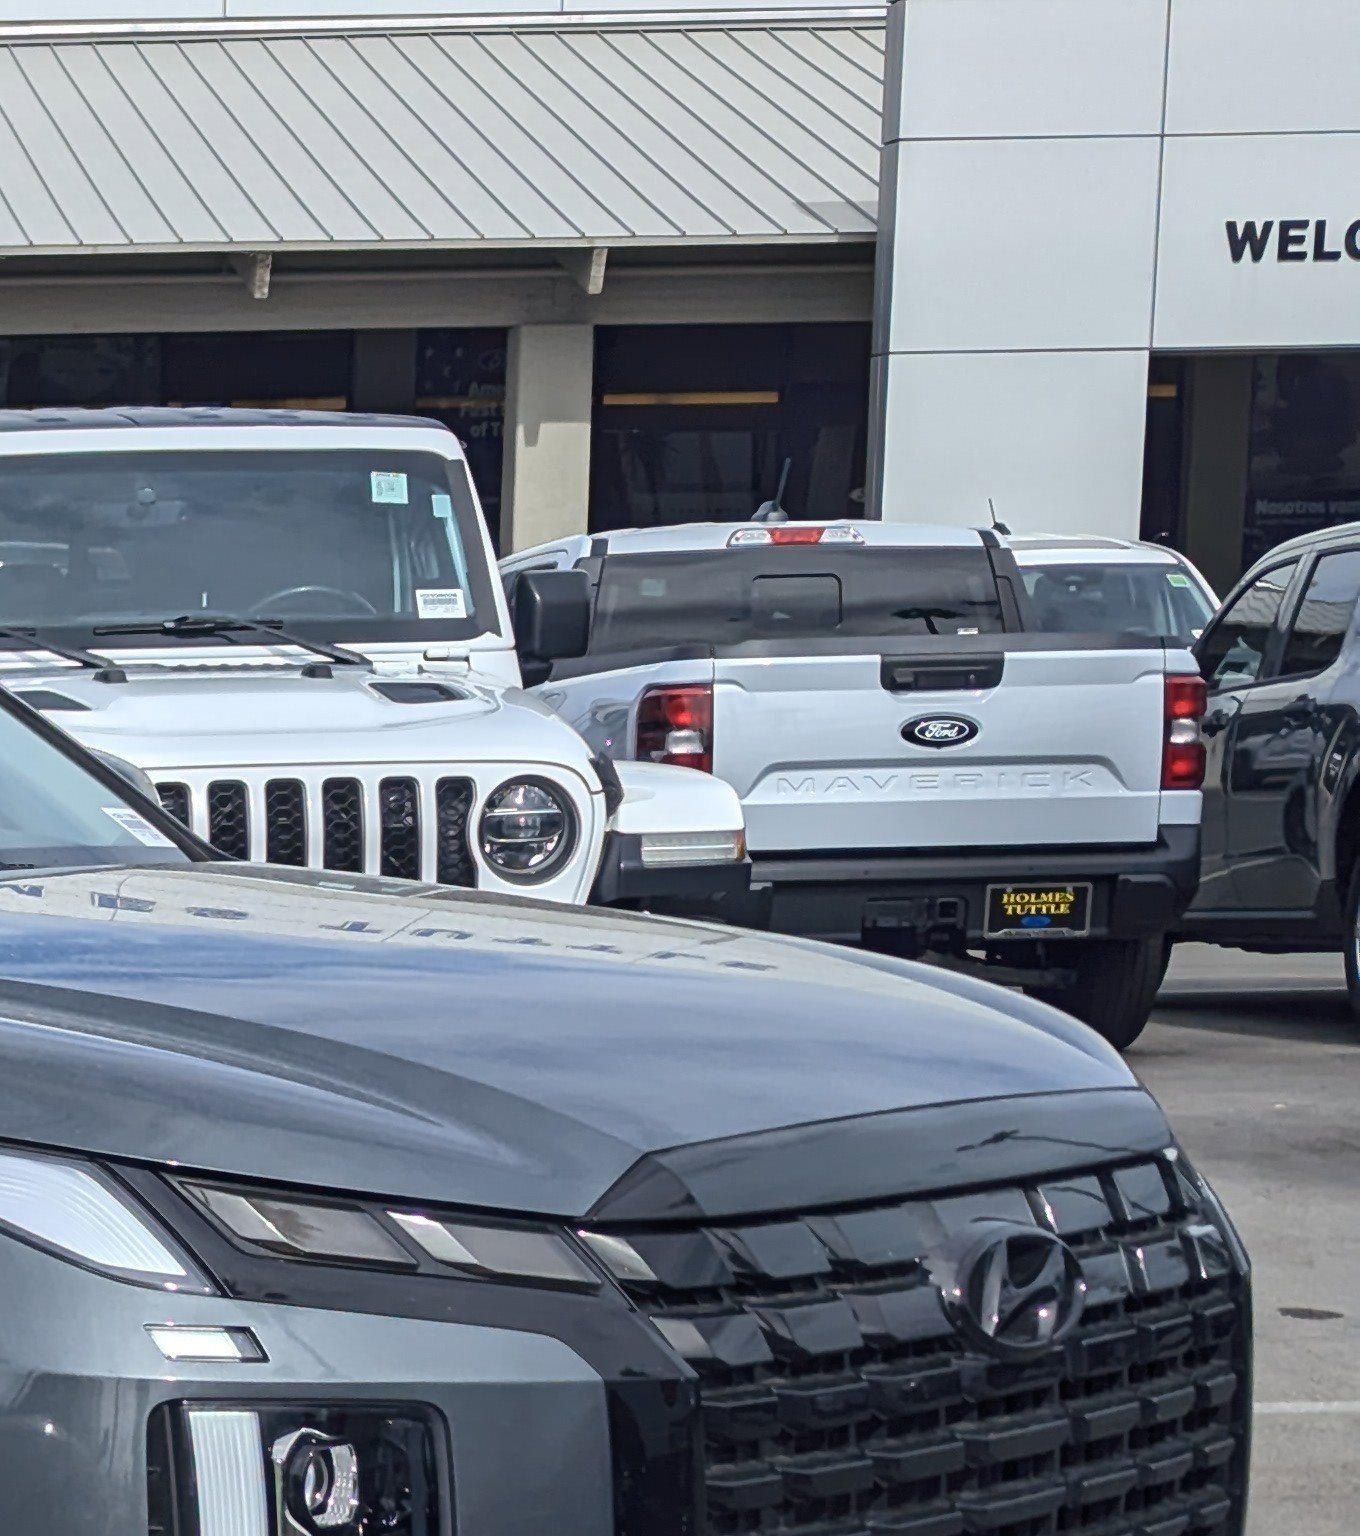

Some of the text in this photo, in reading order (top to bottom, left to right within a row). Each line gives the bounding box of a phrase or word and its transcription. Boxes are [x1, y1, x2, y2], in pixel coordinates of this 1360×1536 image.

[777, 769, 1094, 796] MAVERICK
[1001, 891, 1075, 904] HOLMES
[1004, 903, 1070, 915] TUTTLE
